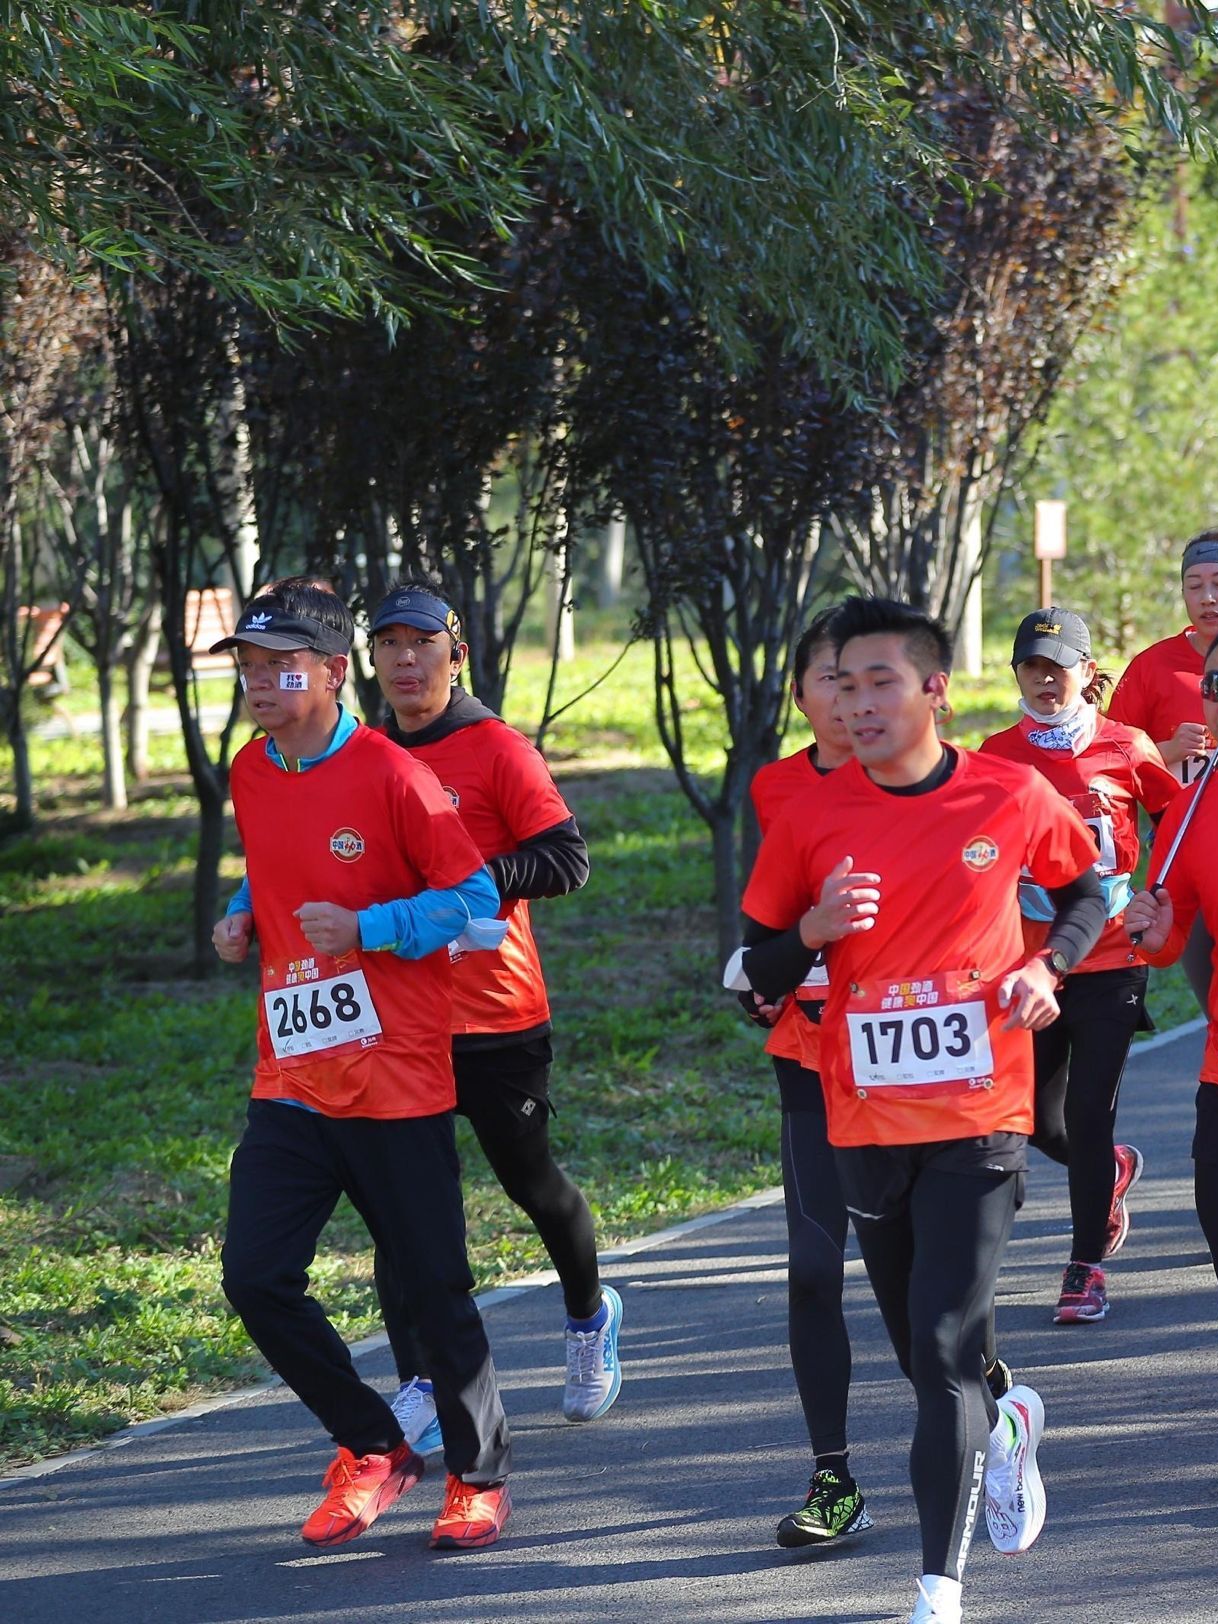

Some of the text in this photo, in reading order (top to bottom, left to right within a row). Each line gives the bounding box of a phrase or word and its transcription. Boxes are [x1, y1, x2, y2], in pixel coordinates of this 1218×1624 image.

[273, 982, 361, 1038] 2668
[861, 1013, 971, 1065] 1703
[1016, 1493, 1026, 1513] new
